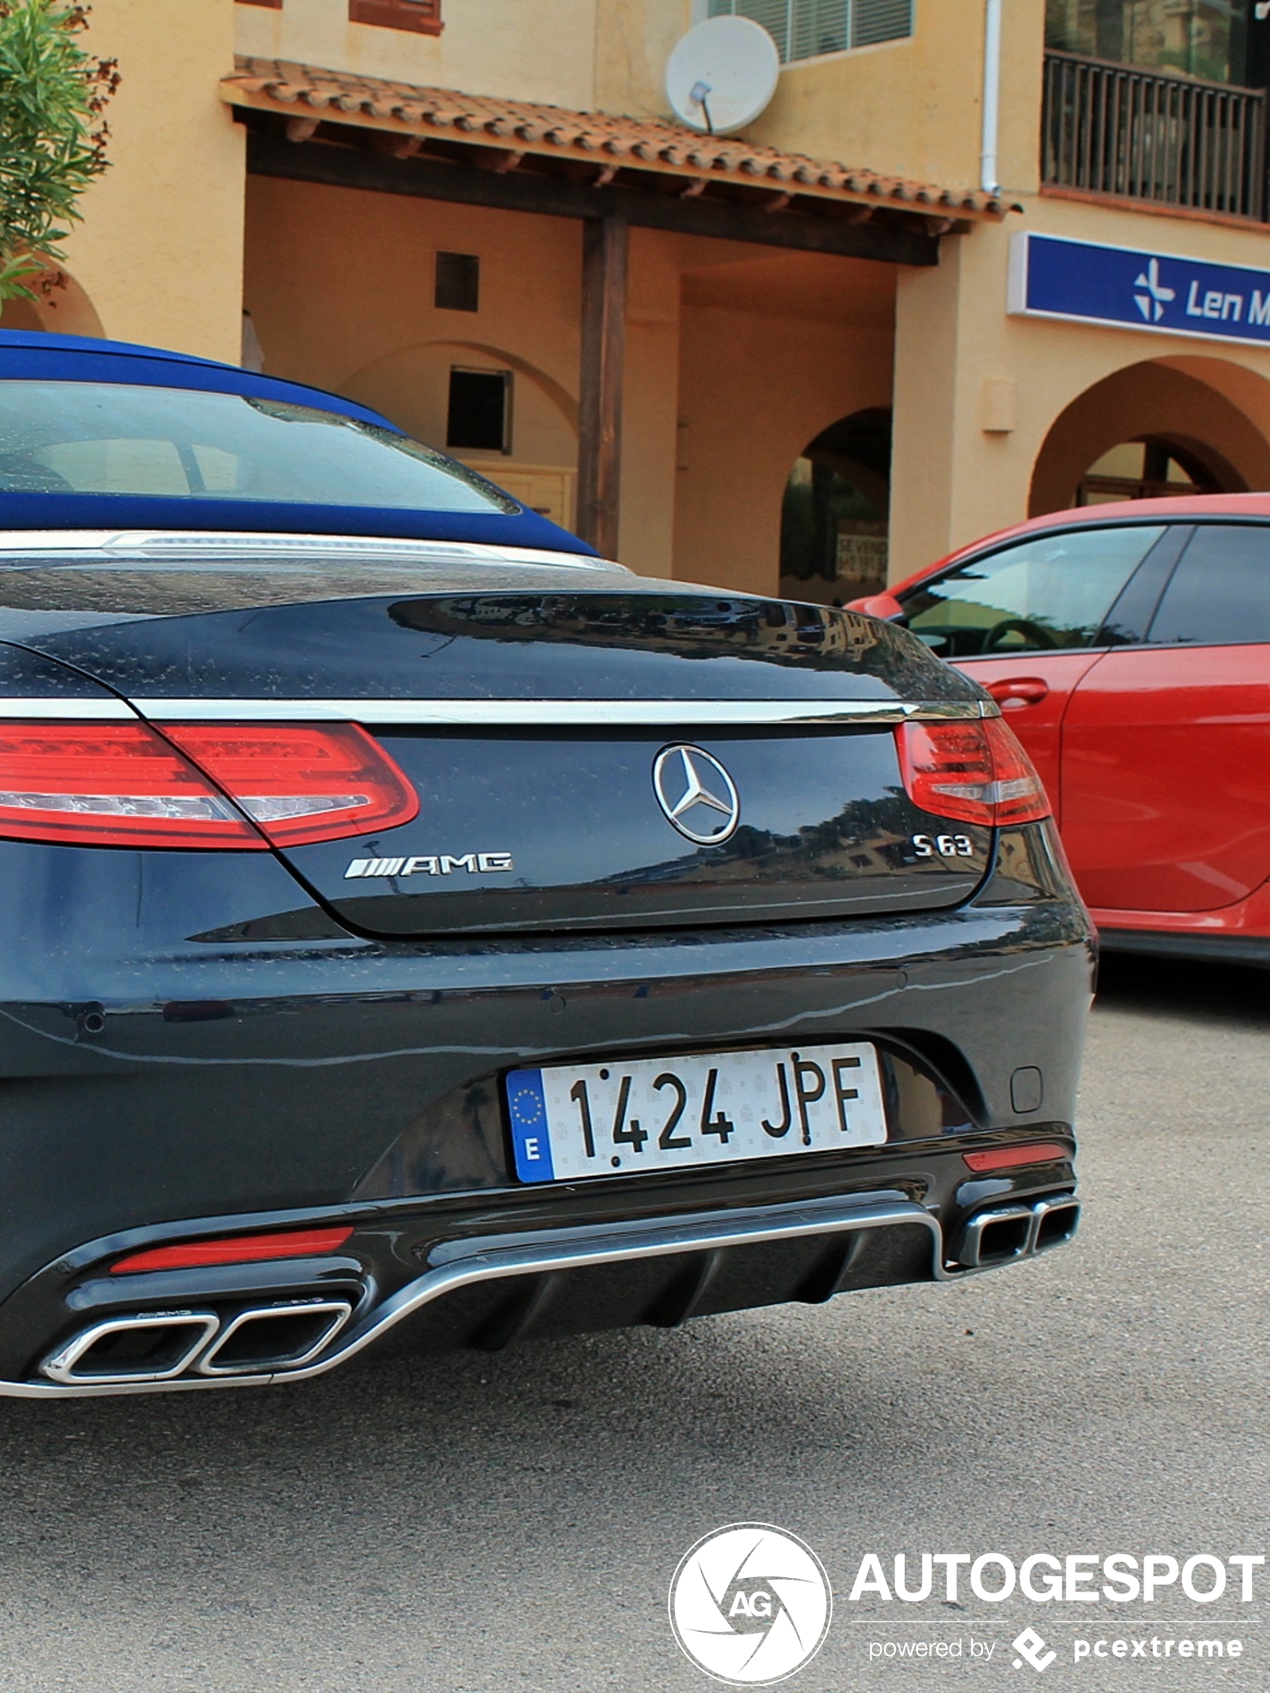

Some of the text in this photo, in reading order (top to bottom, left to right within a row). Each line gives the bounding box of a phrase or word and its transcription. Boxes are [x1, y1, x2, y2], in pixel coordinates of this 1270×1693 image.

[1186, 280, 1243, 322] Len
[912, 834, 974, 857] S 63
[400, 852, 514, 877] AMG
[570, 1056, 862, 1158] 1424 JPF
[525, 1137, 541, 1161] E
